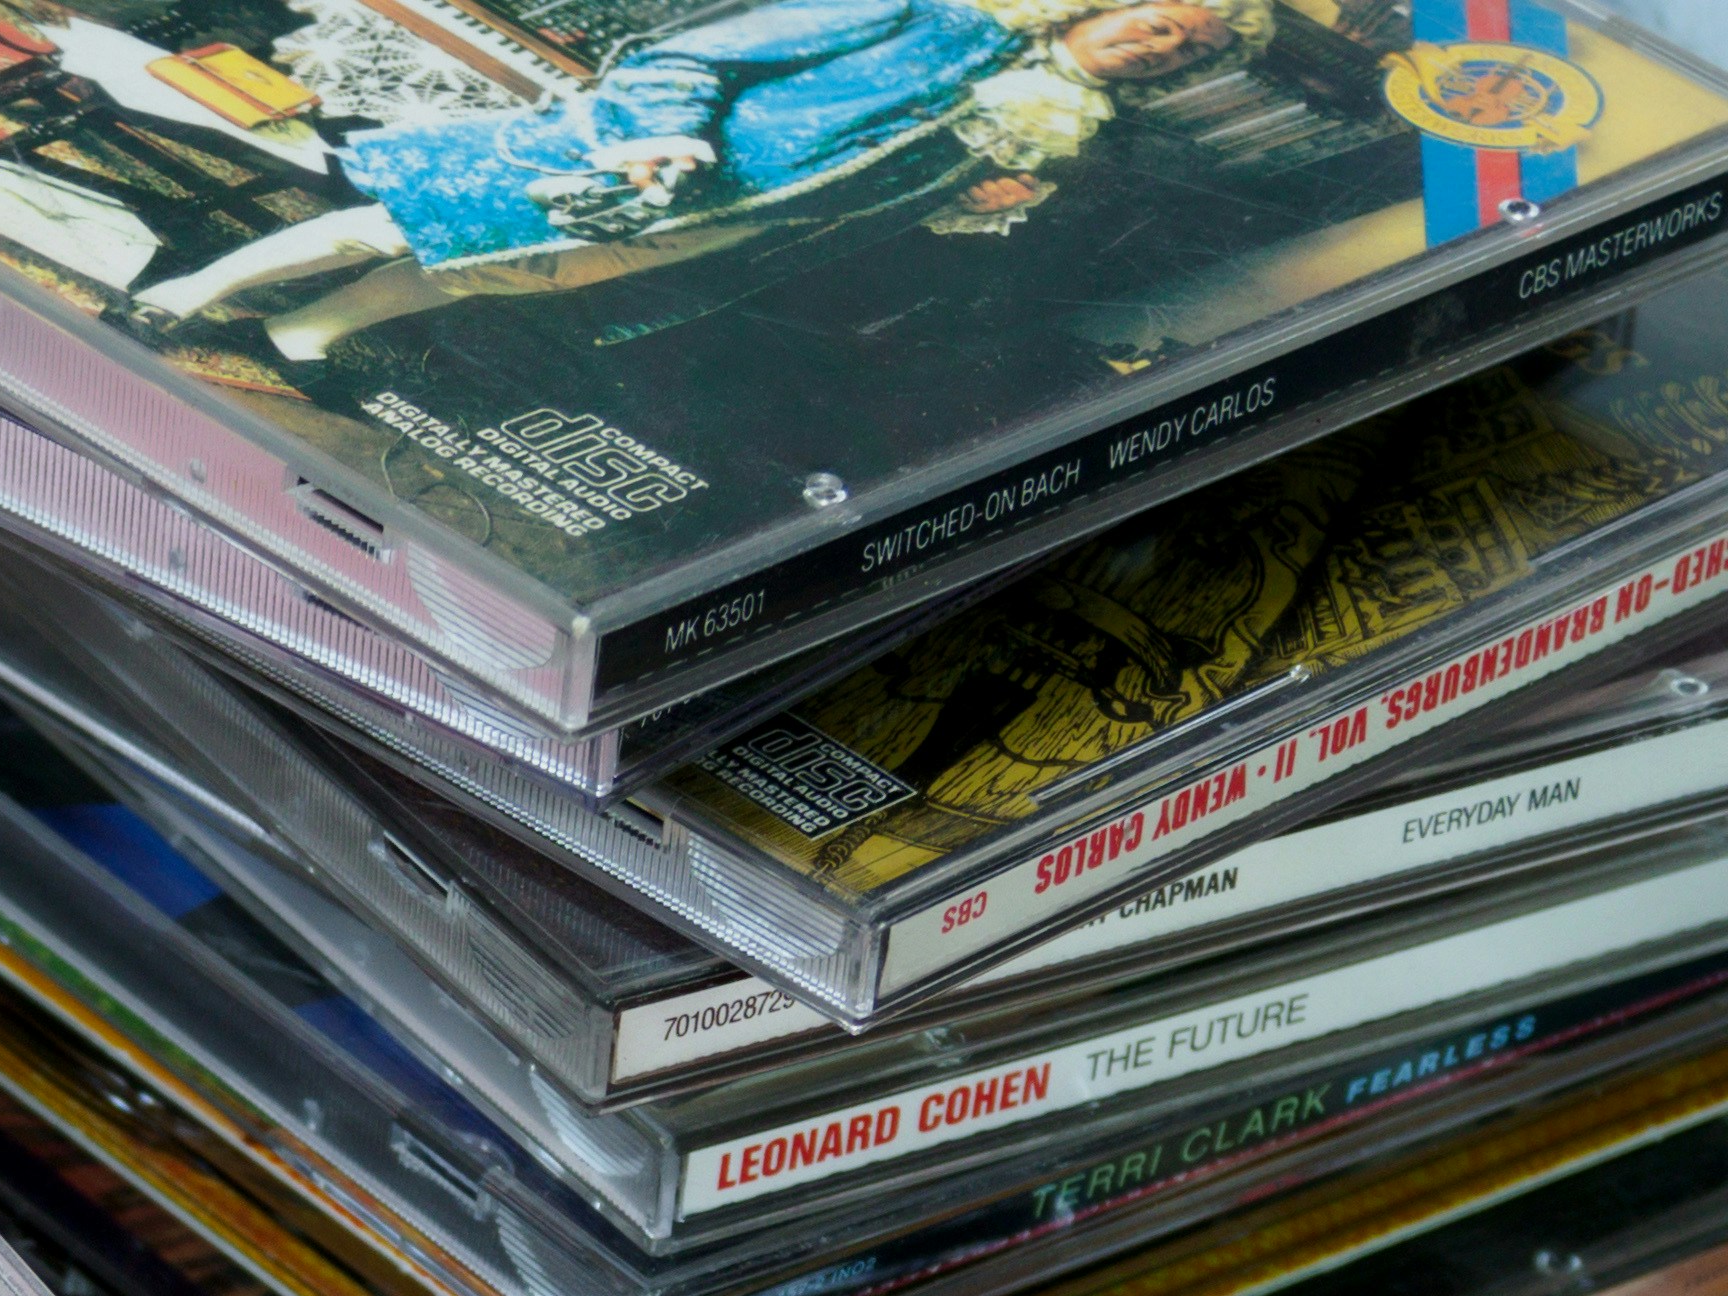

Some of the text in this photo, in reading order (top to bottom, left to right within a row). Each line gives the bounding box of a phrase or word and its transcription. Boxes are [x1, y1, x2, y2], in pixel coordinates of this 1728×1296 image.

[1519, 189, 1723, 300] CBS MASTERWORKS
[376, 391, 606, 531] DIGITALLY MASTERED
[600, 427, 709, 490] COMPACT
[1108, 378, 1276, 470] WENDY CARLOS
[362, 402, 588, 537] ANALOG RECORDING
[477, 427, 632, 520] DIGITAL AUDIO
[860, 458, 1081, 572] SWITCHED-ON BACH
[1615, 537, 1728, 623] HED-ON
[665, 589, 767, 654] MK 63501
[821, 744, 904, 794] COMPACT
[1274, 743, 1297, 782] II
[1310, 706, 1367, 762] VOL.
[715, 768, 819, 834] RECORDING
[733, 746, 794, 787] DIGITAL
[794, 777, 849, 820] AUDIO
[740, 768, 831, 828] MASTERED
[1152, 763, 1246, 842] WENDY
[1034, 818, 1144, 894] CARLOS
[1118, 867, 1239, 920] CHAPMAN
[1403, 794, 1521, 844] EVERYDAY
[1527, 776, 1582, 812] MAN
[942, 891, 987, 934] CBS
[716, 992, 1311, 1192] LEONARD COHEN THE FUTURE
[1030, 1013, 1539, 1219] TERRI CLARK FEARLESS
